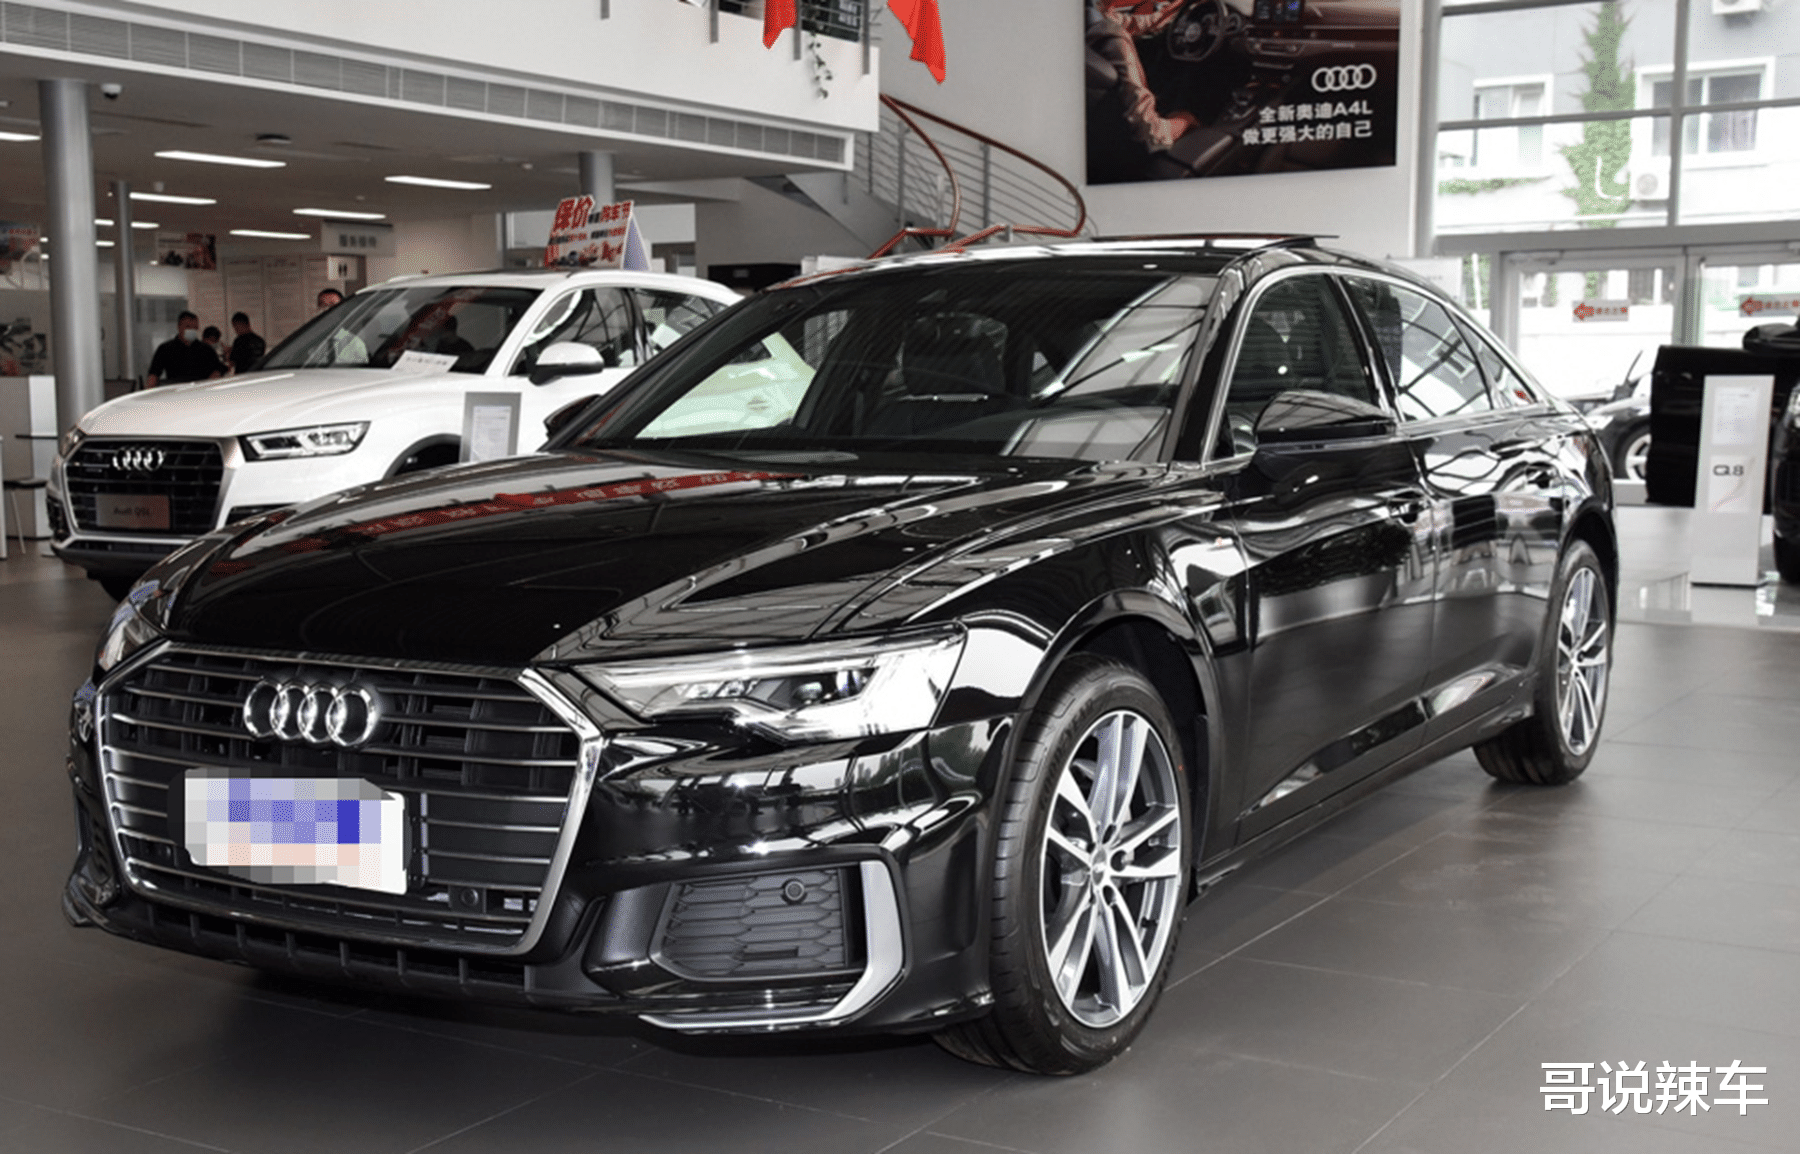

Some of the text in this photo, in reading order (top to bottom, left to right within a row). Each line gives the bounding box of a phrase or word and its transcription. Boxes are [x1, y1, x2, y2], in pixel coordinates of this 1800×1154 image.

[1259, 100, 1373, 124] 全新奥迪A4L
[1242, 120, 1373, 146] 做更强大的自己
[1712, 464, 1745, 477] Q8
